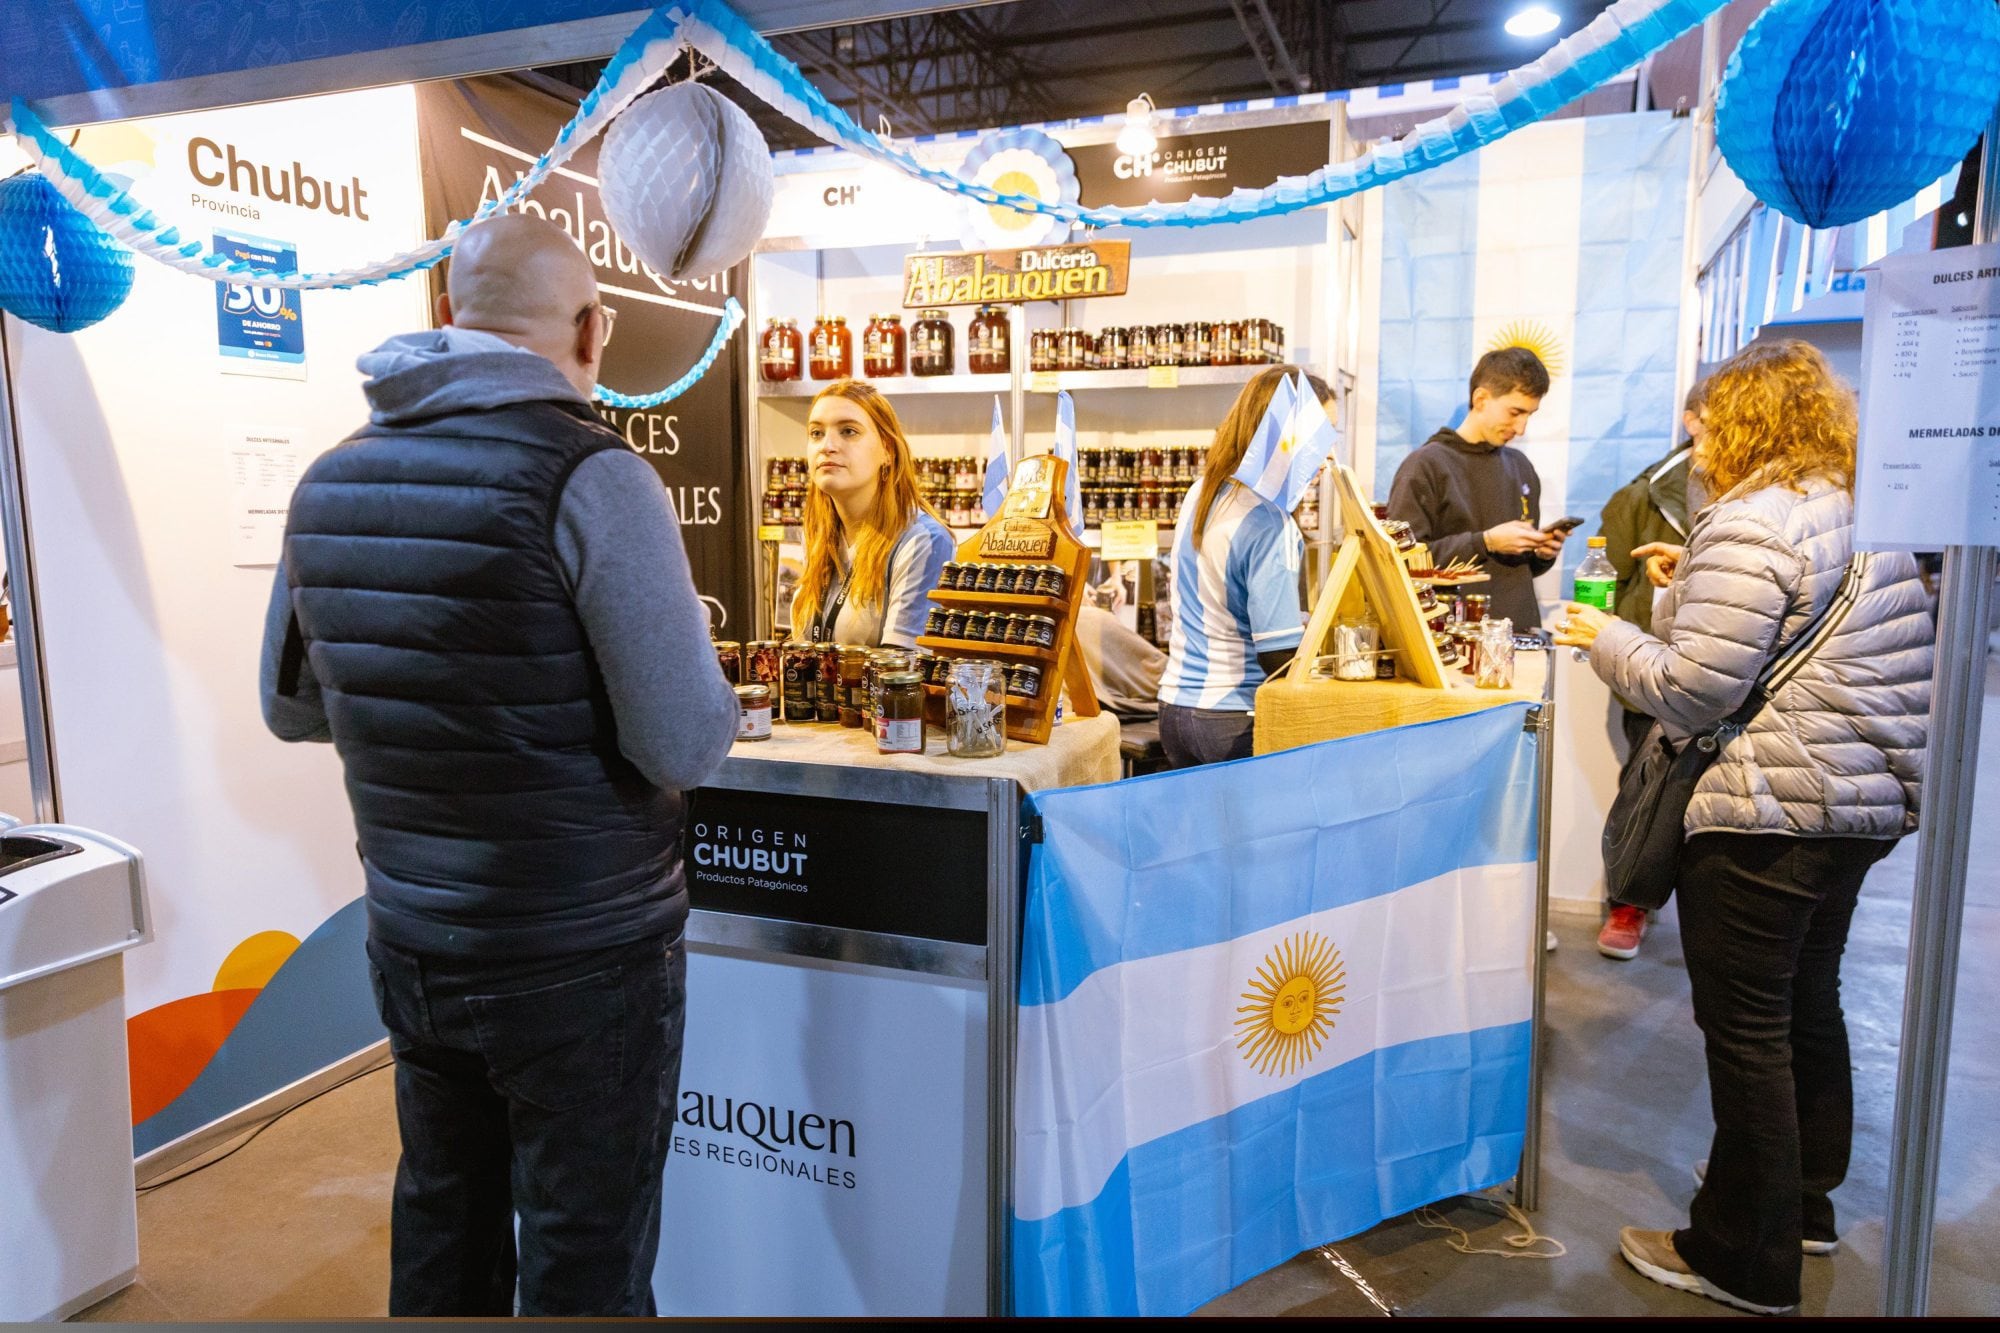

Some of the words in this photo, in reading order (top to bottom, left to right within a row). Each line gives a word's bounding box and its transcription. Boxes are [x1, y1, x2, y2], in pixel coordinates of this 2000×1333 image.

[1163, 145, 1228, 161] ORIGEN
[1163, 155, 1228, 175] CHUBUT
[188, 136, 369, 222] Chubut
[191, 193, 260, 220] Provincia
[1932, 269, 1974, 285] DULCES
[1908, 426, 1985, 438] MERMELADAS
[694, 822, 807, 849] ORIGEN
[693, 842, 809, 877] CHUBUT
[696, 870, 746, 886] Productos
[747, 876, 809, 894] Patagónicos
[668, 1136, 701, 1157] ES
[706, 1142, 857, 1190] REGIONALES
